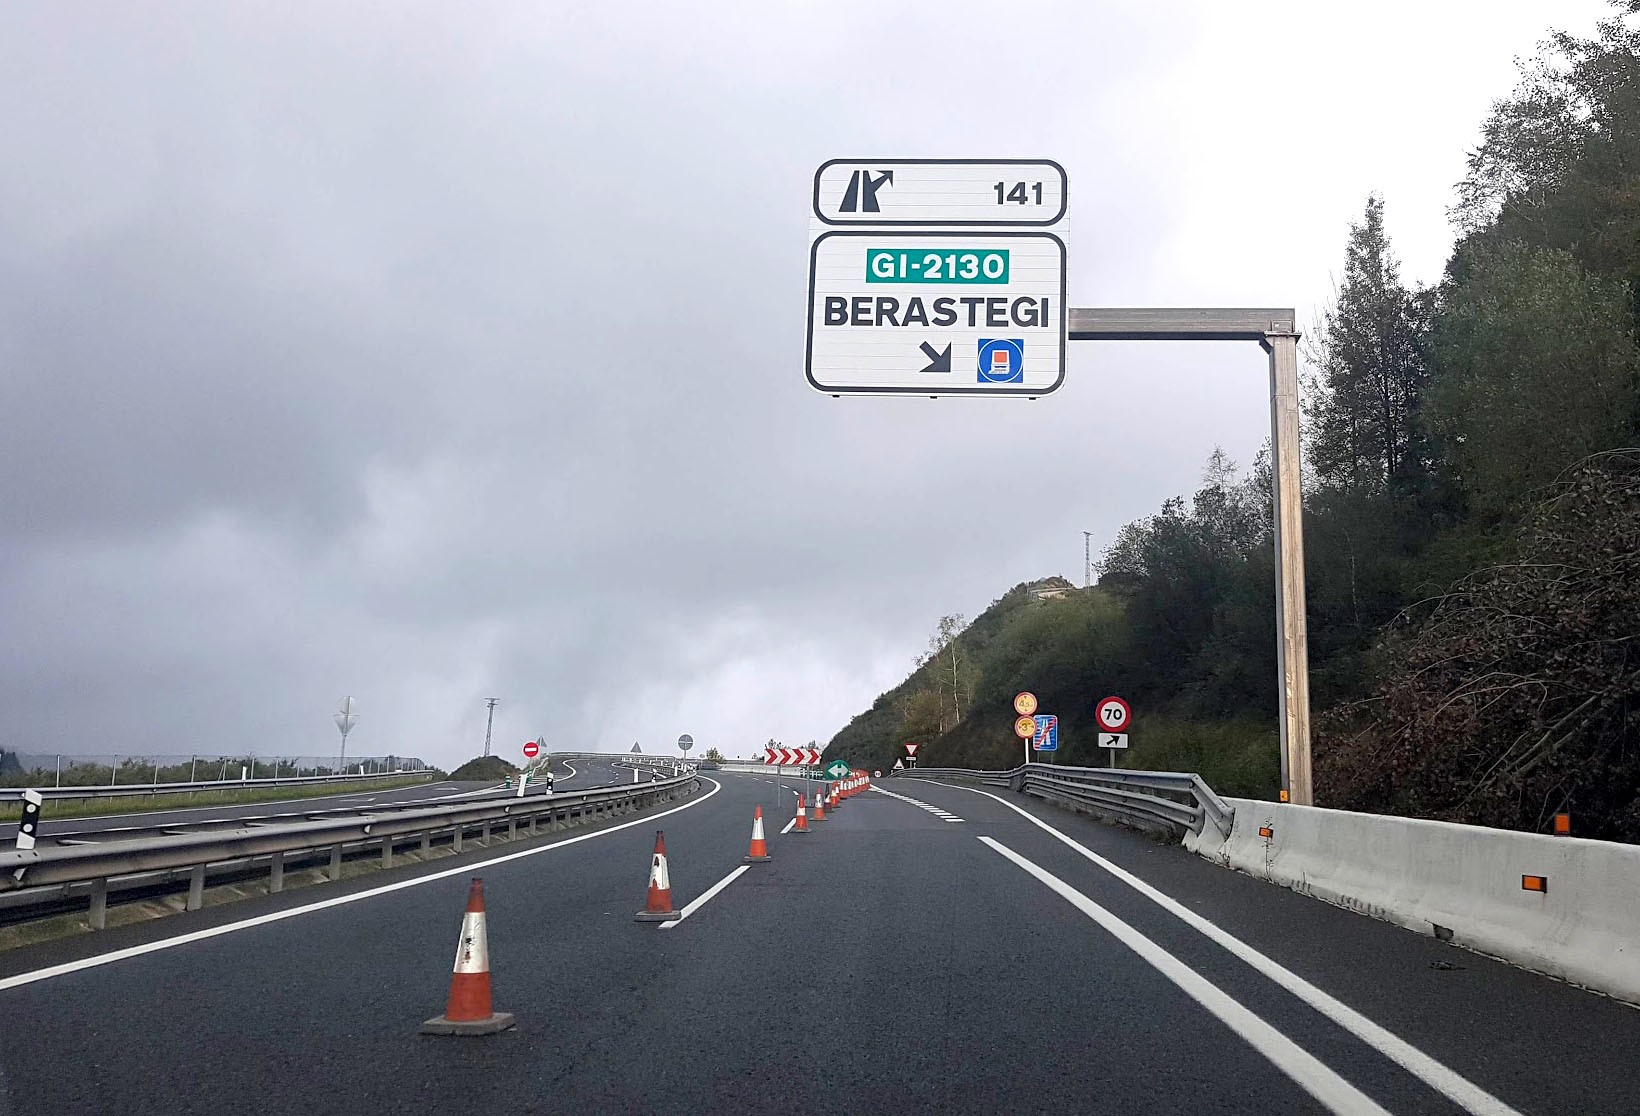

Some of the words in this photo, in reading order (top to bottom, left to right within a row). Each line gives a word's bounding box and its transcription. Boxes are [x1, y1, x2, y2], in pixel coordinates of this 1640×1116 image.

[993, 181, 1042, 204] 141
[871, 252, 1005, 279] GI-2130
[824, 296, 1049, 327] BERASTEGI
[1104, 708, 1123, 720] 70
